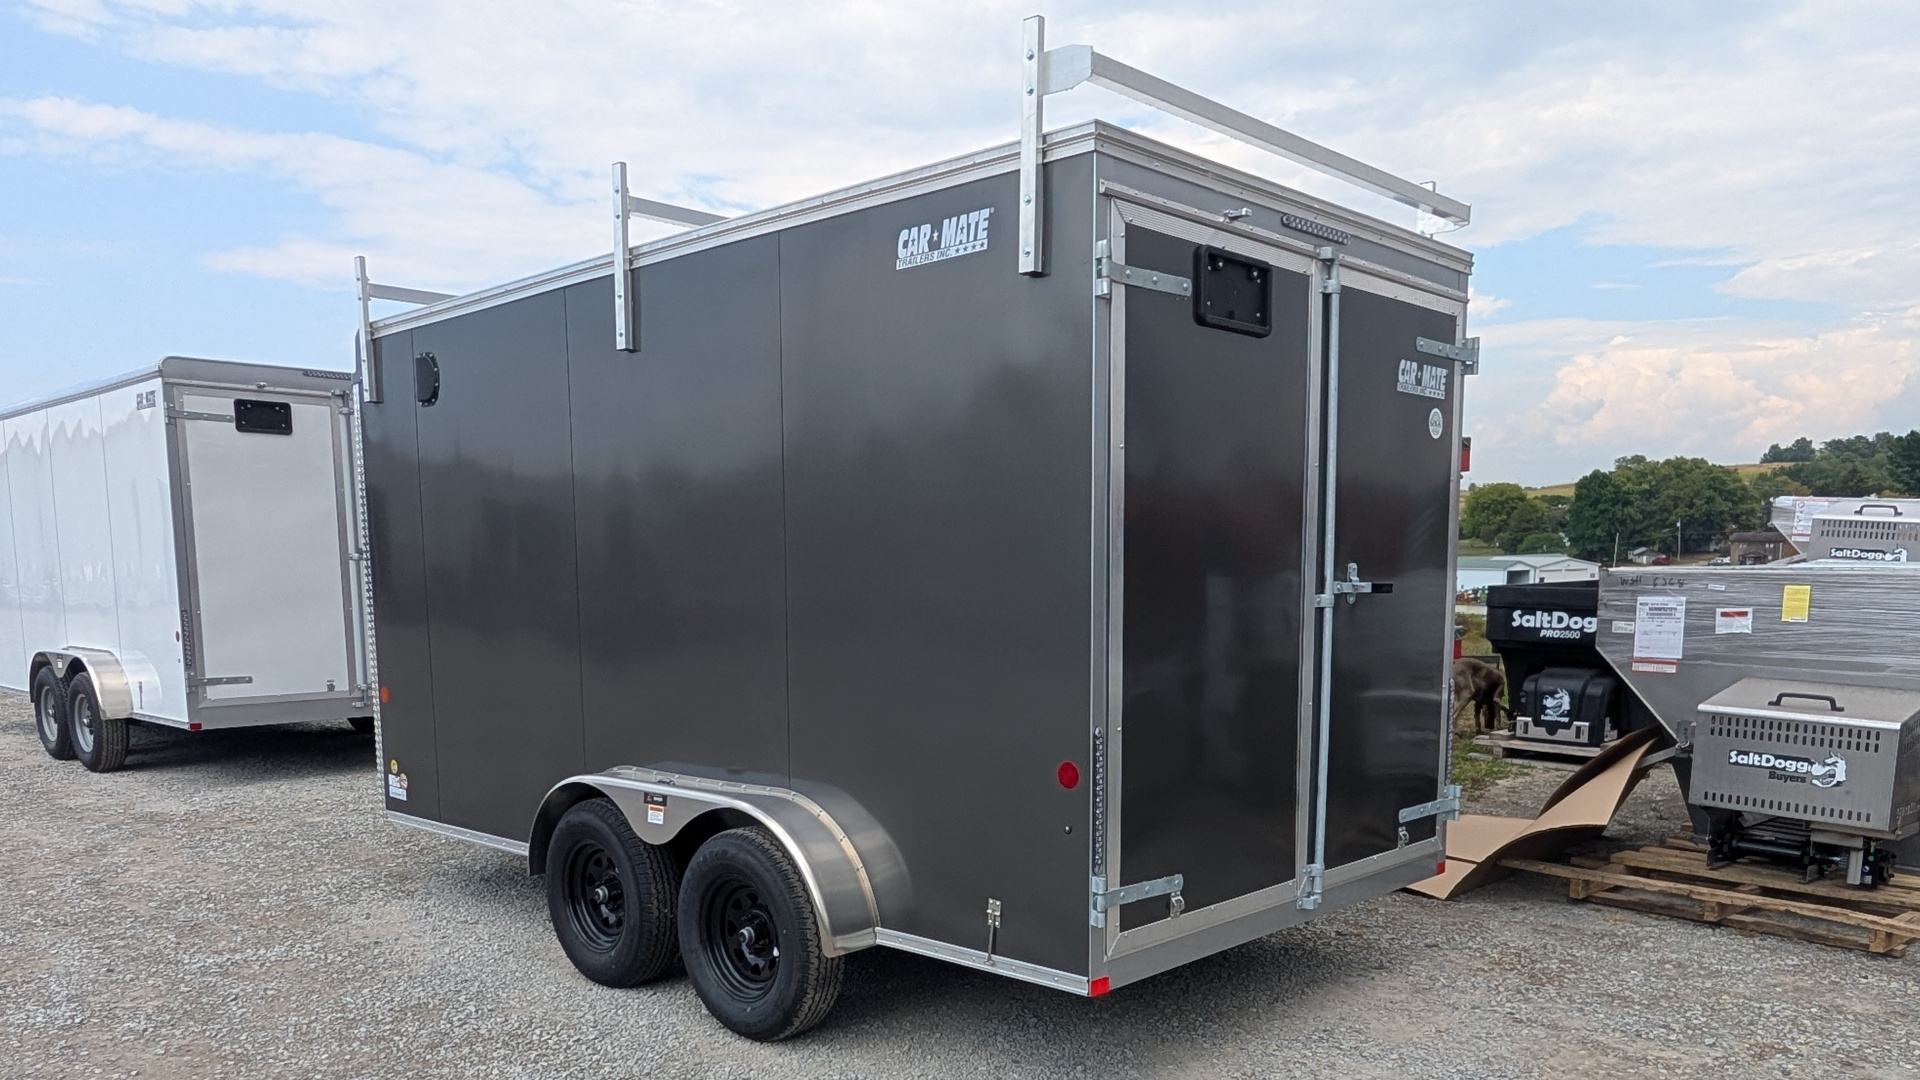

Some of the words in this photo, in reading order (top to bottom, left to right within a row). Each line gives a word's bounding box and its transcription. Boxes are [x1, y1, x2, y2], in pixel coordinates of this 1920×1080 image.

[898, 223, 931, 259] CAR
[940, 207, 990, 249] MATE
[898, 251, 935, 268] TRAILERS
[1398, 359, 1418, 385] CAR
[1421, 364, 1447, 391] MATE
[1830, 548, 1885, 560] SaltDogg
[1511, 609, 1598, 633] SaltDog
[1540, 629, 1581, 639] PRO2500
[1729, 750, 1809, 773] SaltDogg
[1768, 771, 1807, 784] Buyers
